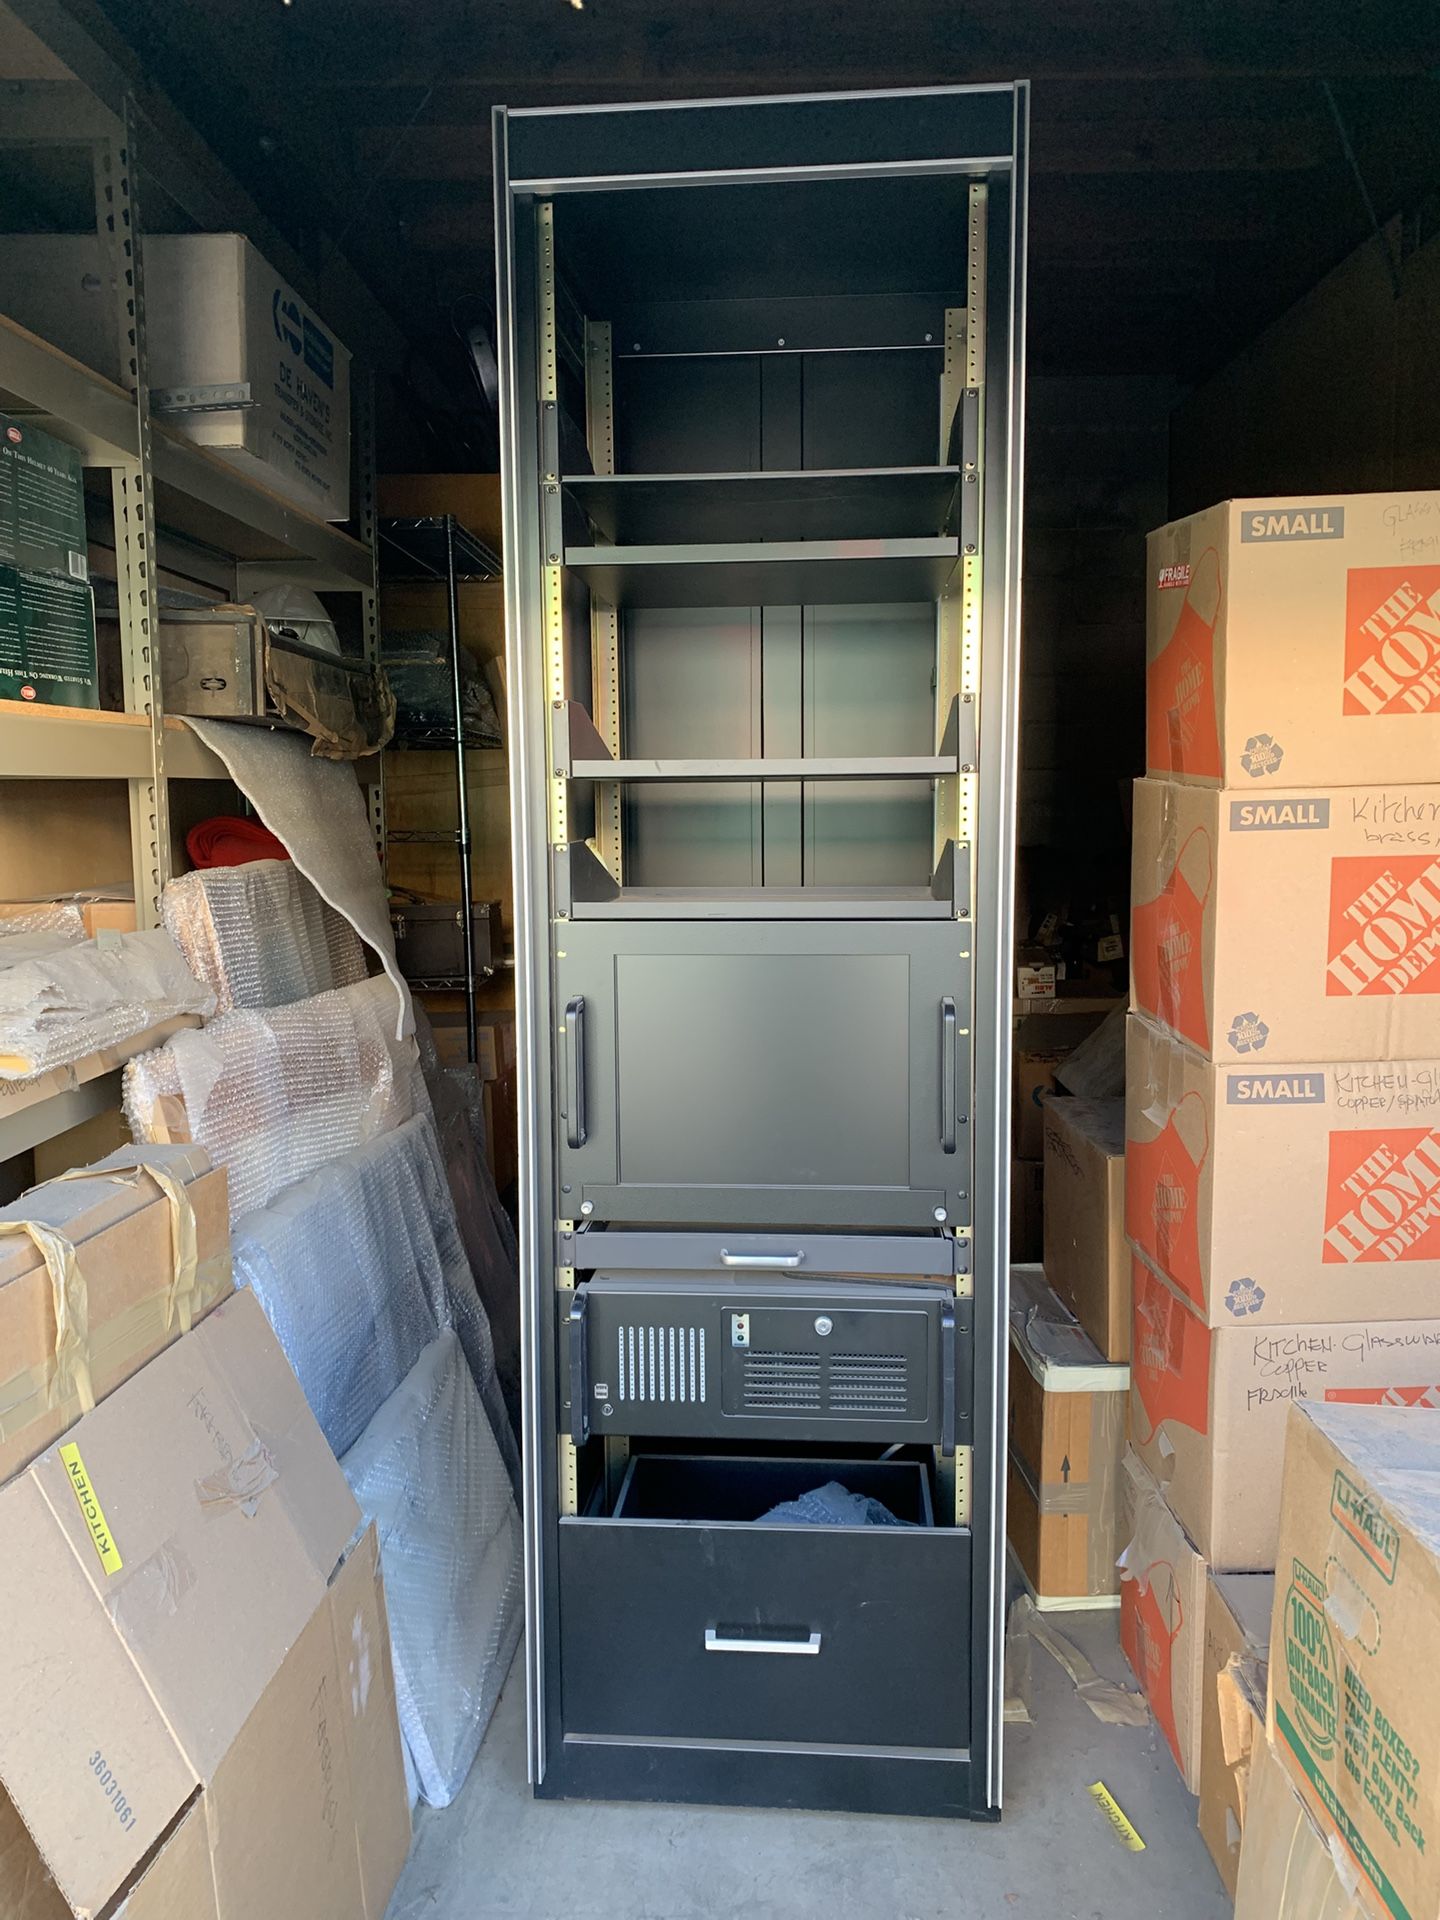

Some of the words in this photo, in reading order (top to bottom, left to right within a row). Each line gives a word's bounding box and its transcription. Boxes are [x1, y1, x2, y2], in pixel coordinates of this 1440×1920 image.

[1251, 513, 1334, 537] SMALL
[1164, 564, 1190, 582] FRAGILE
[1360, 581, 1423, 641] THE
[1240, 804, 1320, 826] SMALL
[1342, 870, 1403, 926] THE
[1237, 1079, 1316, 1099] SMALL
[1340, 1143, 1399, 1198] THE
[69, 1461, 110, 1555] KITCHEN
[1337, 1478, 1392, 1560] U-HAUL
[1291, 1597, 1328, 1671] 100%
[1288, 1637, 1336, 1712] BUY-BACK
[1290, 1670, 1336, 1740] GUARANTEE
[1344, 1664, 1371, 1716] NEED
[1374, 1706, 1420, 1782] BOXES?
[1344, 1691, 1370, 1743] TAKE
[1372, 1732, 1418, 1810] PLENTY!
[89, 1750, 136, 1833] 36031061
[1344, 1747, 1361, 1785] the
[1092, 1791, 1134, 1842] KITCHEN
[1314, 1773, 1382, 1889] uhaul.com
[1371, 1760, 1393, 1807] Buy
[1396, 1797, 1425, 1856] Back
